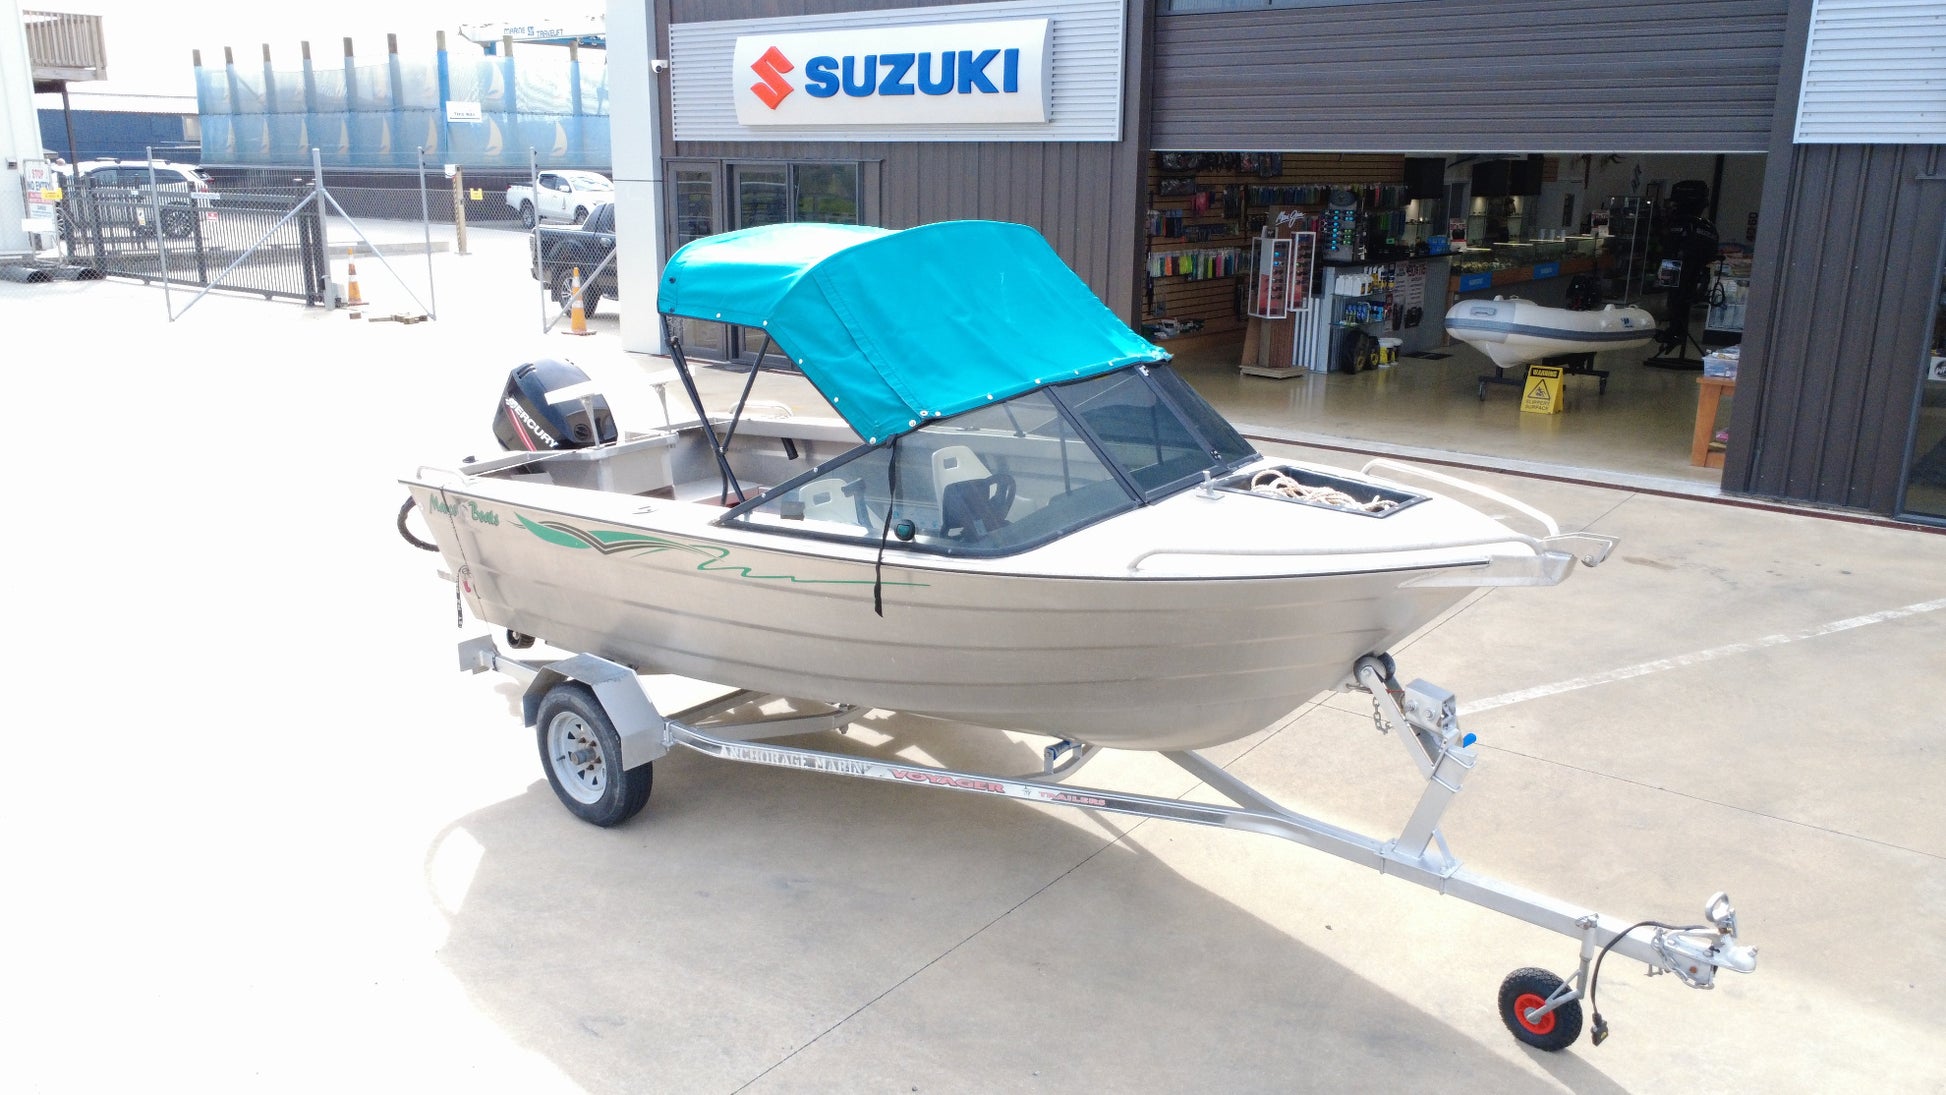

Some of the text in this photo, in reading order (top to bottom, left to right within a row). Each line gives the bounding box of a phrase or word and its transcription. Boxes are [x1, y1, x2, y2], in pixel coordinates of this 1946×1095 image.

[805, 48, 1019, 98] SUZUKI
[720, 744, 808, 769] ANCHORAGE
[890, 768, 1006, 794] VOYAGER
[1038, 791, 1106, 807] TRAILERS
